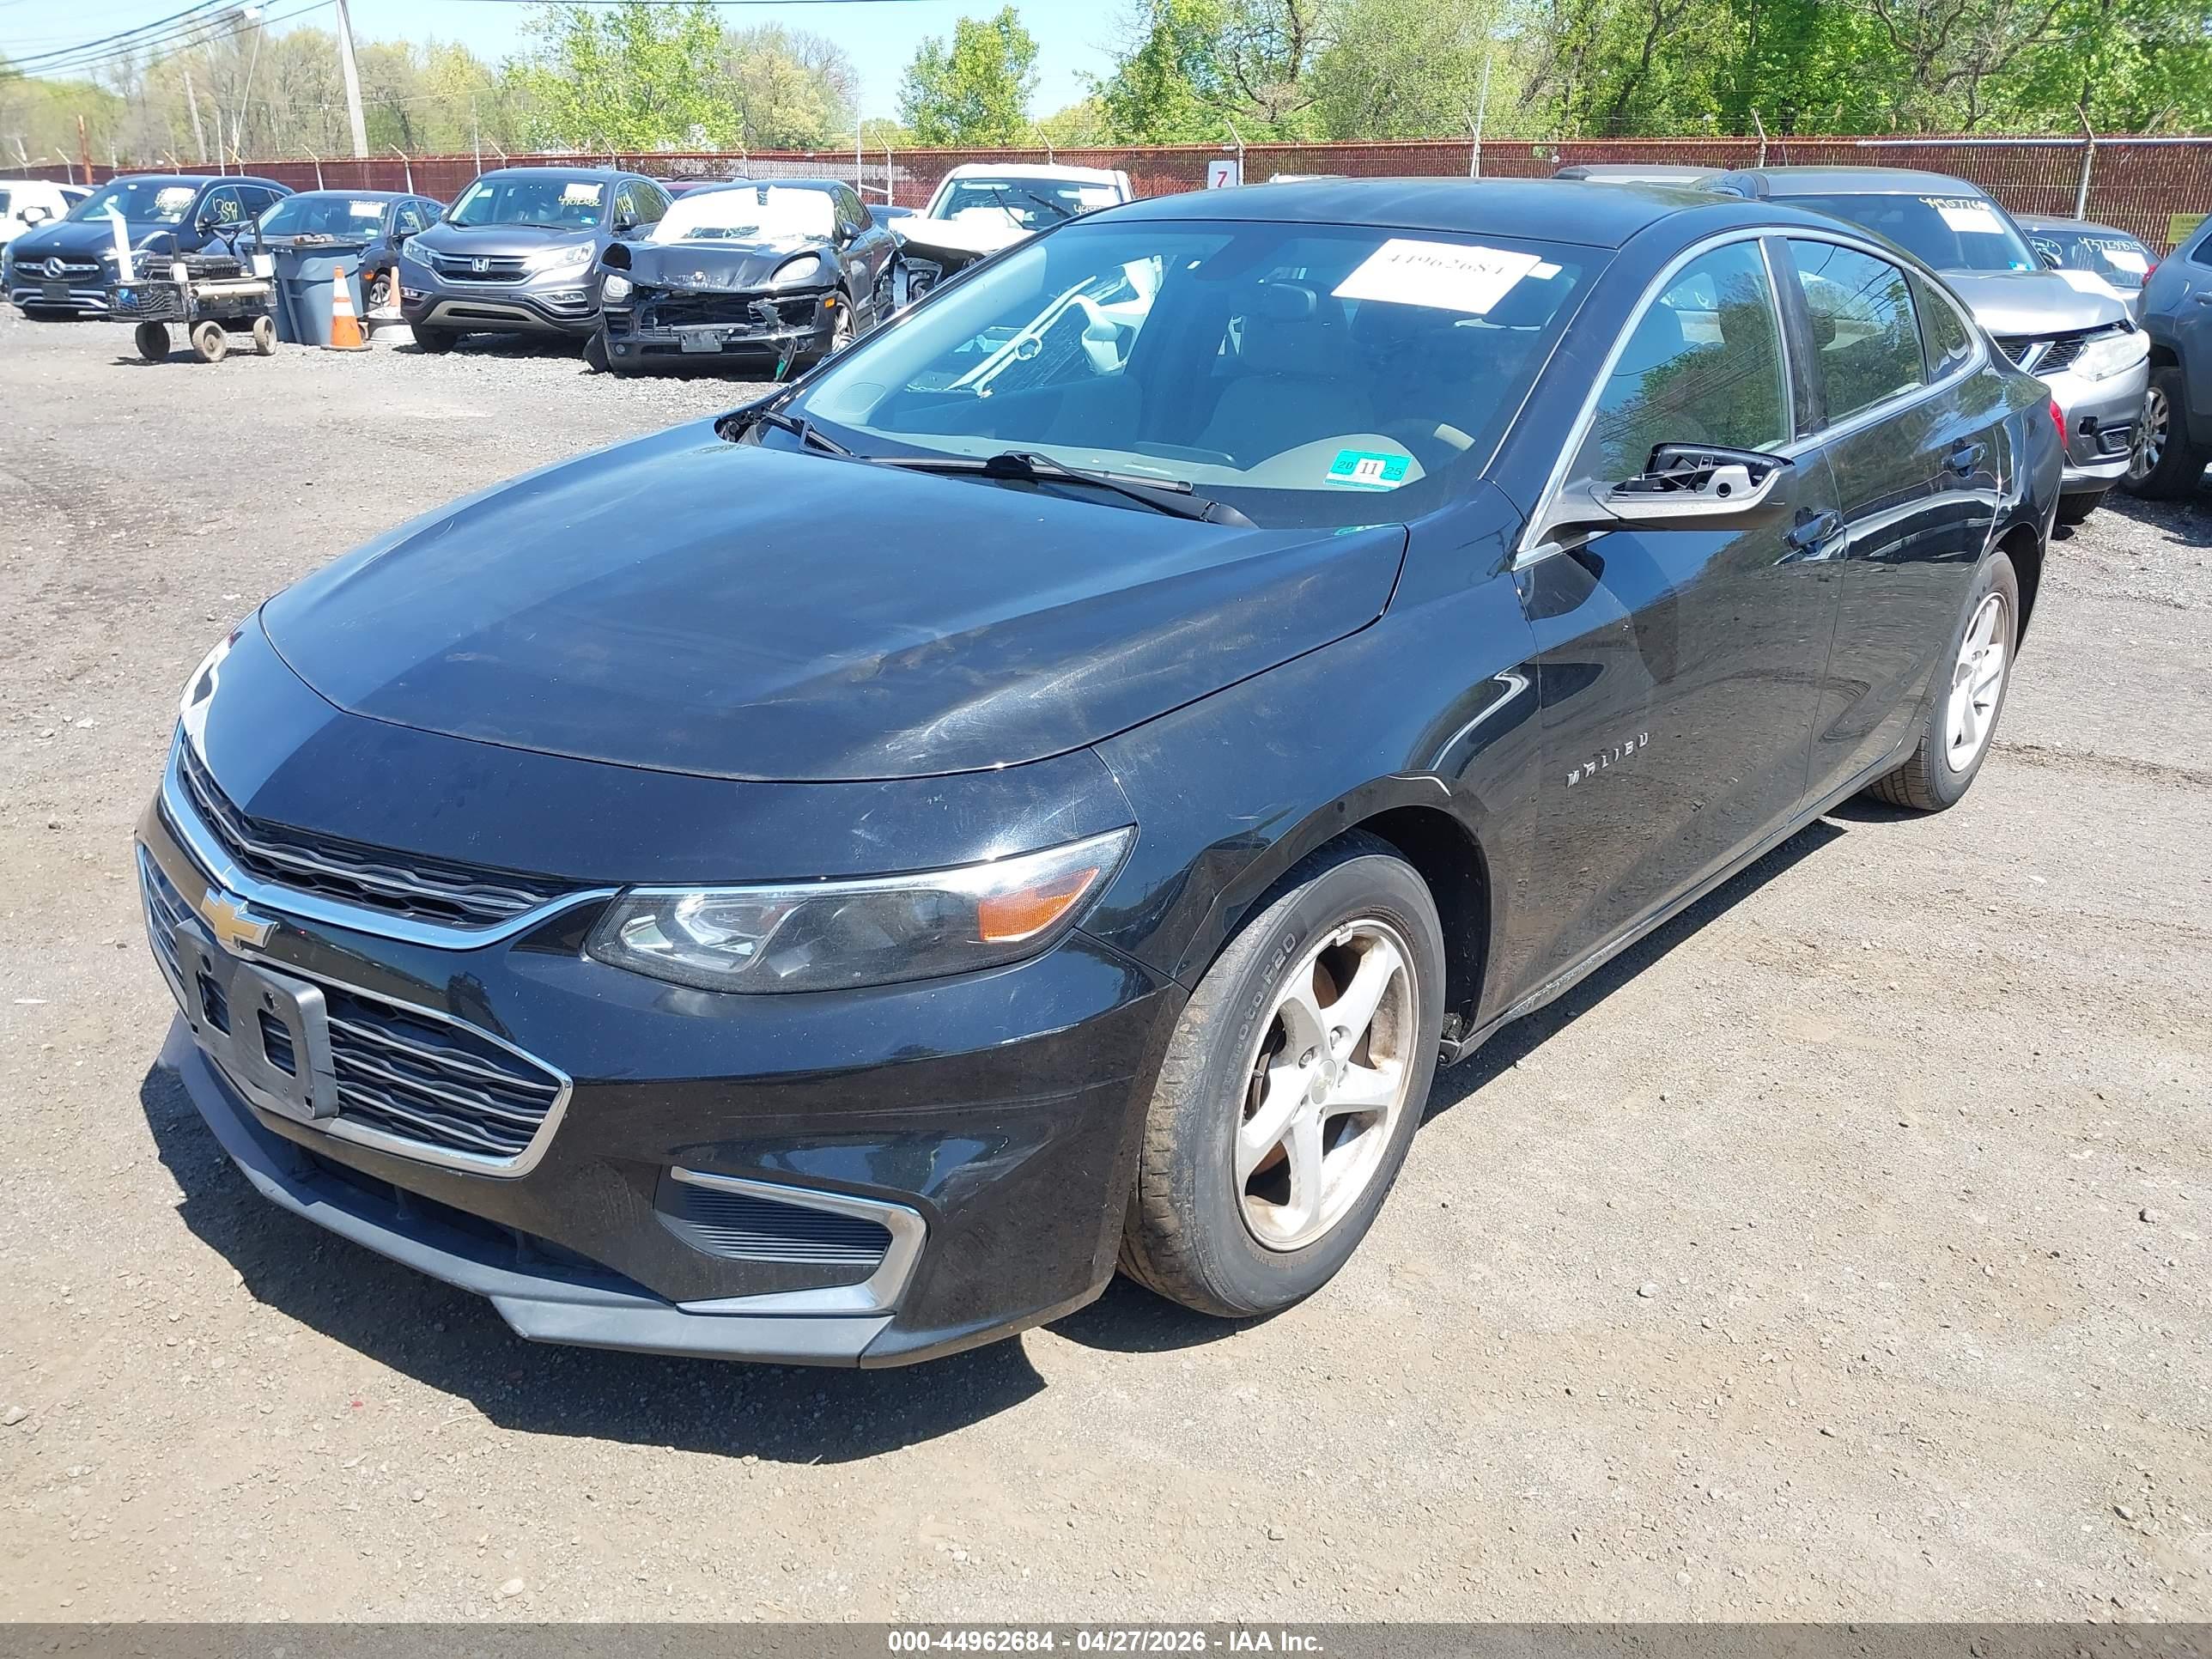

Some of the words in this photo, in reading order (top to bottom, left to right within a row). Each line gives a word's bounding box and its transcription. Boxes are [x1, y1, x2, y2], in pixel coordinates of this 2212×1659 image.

[1217, 171, 1228, 188] 7
[1359, 462, 1378, 476] 11
[1386, 467, 1402, 476] 25
[1566, 732, 1649, 789] MALIBU
